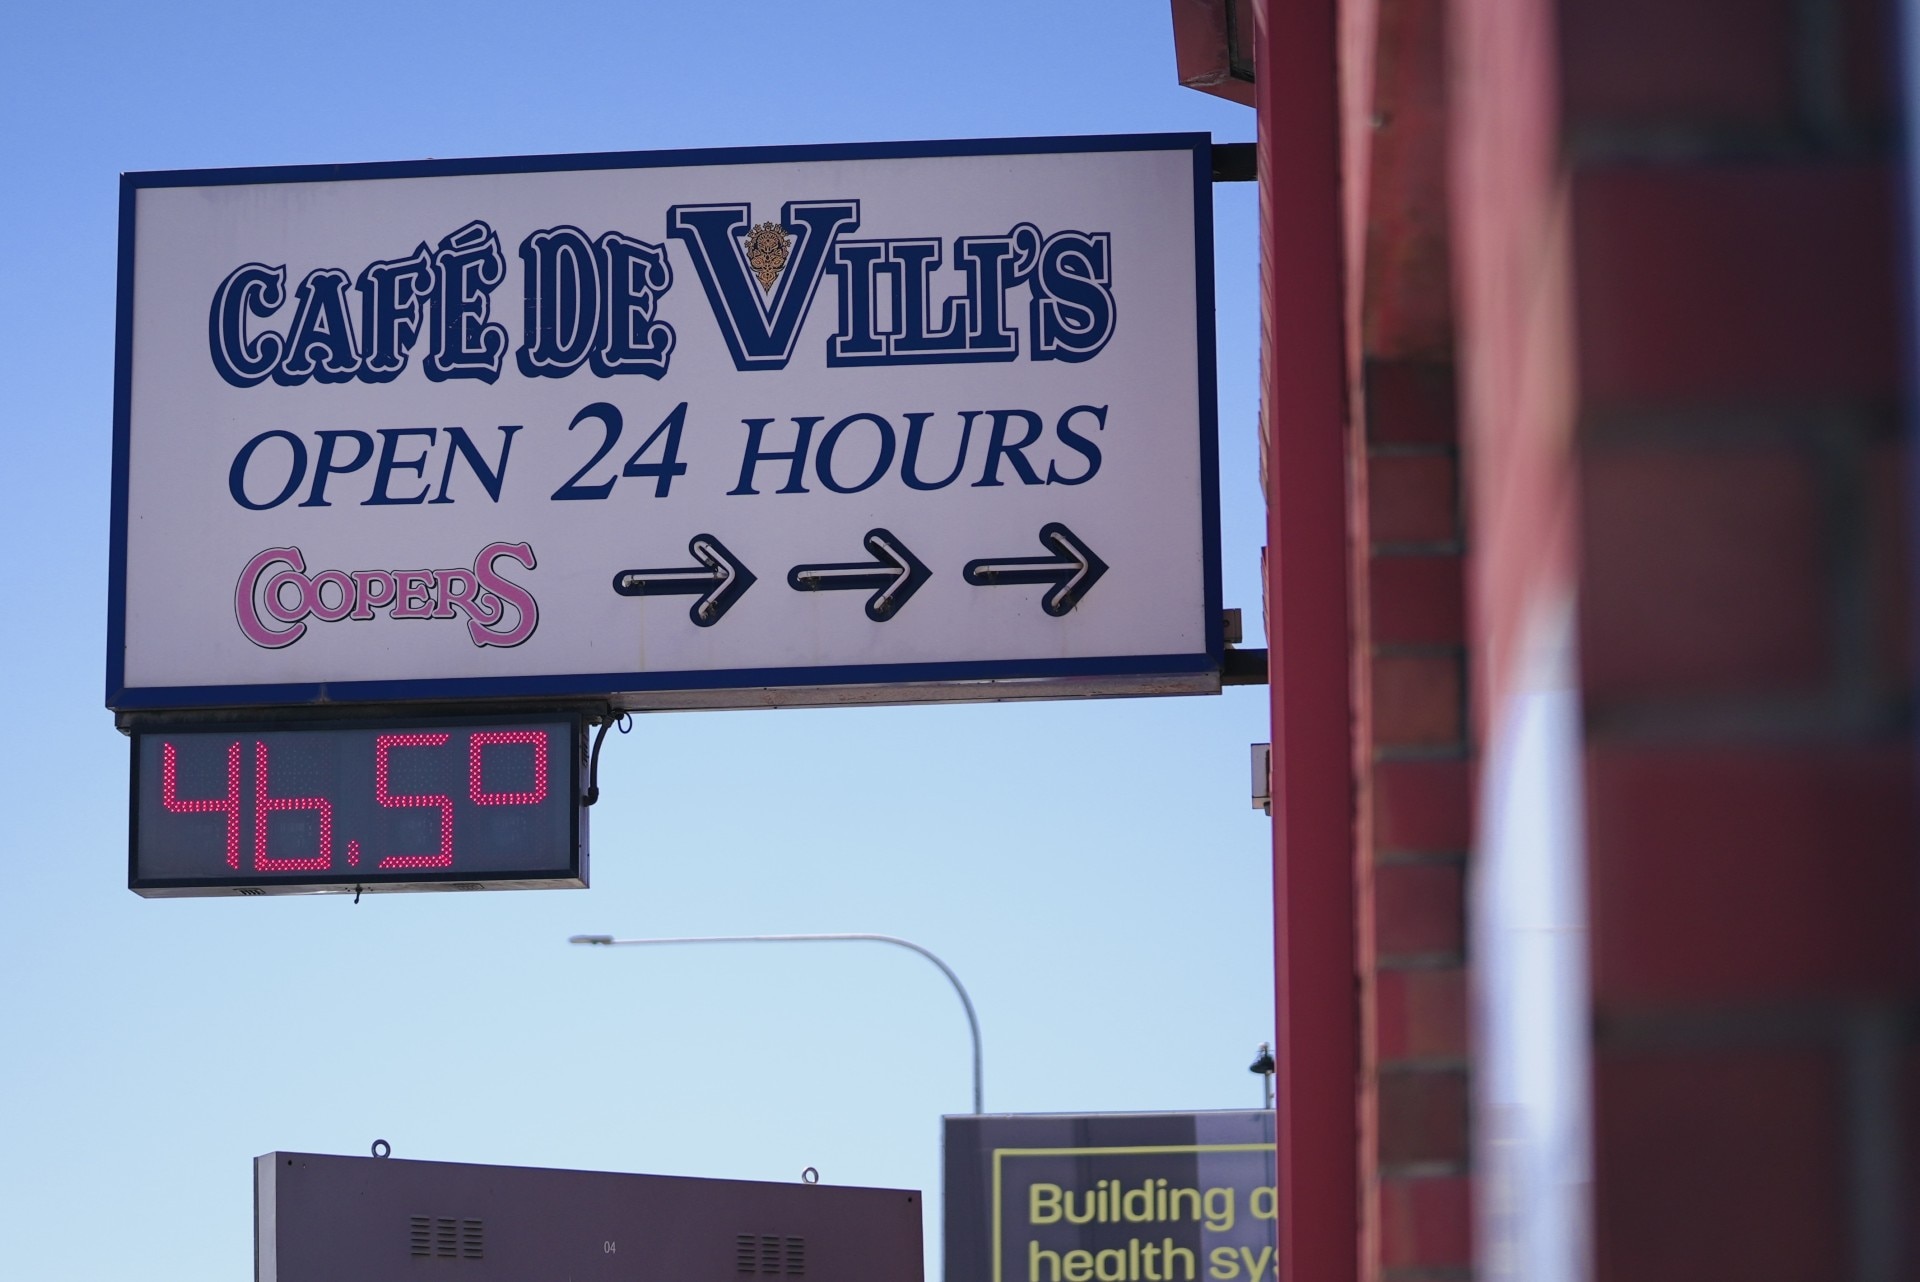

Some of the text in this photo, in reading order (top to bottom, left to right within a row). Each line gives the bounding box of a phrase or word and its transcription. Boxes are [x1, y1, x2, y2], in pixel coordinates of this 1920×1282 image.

[209, 220, 509, 388] CAFÉ
[516, 225, 676, 381] DE
[228, 401, 1109, 511] OPEN 24 HOURS
[1029, 1178, 1235, 1232] Building
[603, 1240, 616, 1254] 04
[1029, 1237, 1277, 1282] health sy
